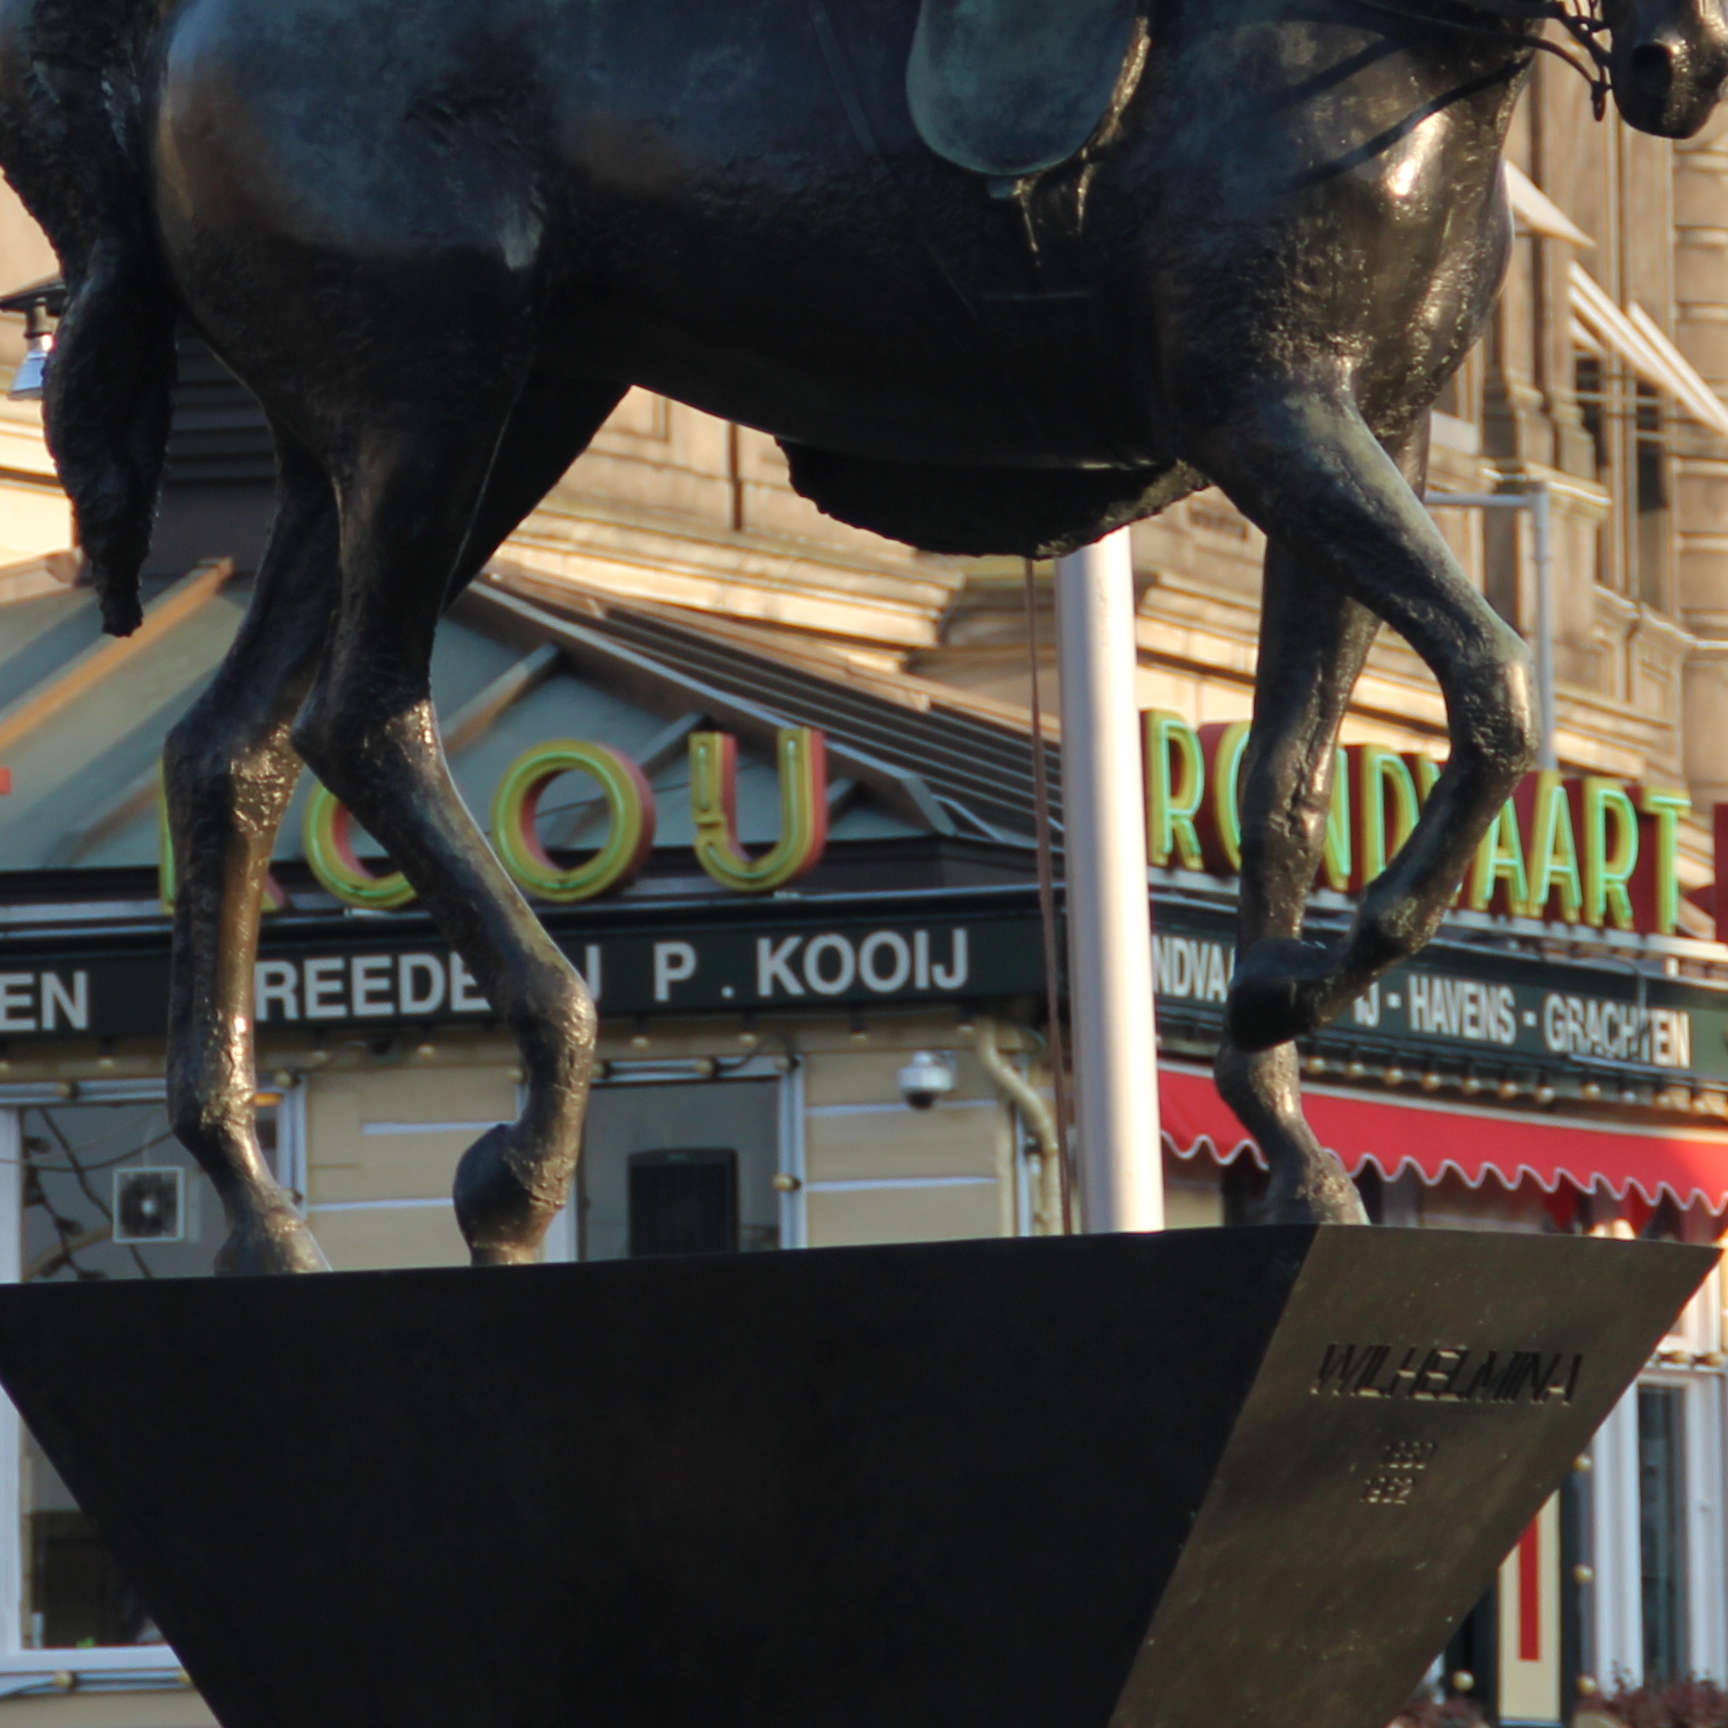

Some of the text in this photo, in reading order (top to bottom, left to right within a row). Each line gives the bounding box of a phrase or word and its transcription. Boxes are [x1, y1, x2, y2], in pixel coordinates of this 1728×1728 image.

[1139, 708, 1691, 934] RNDAART
[253, 943, 602, 1022] REEDEJ
[757, 928, 969, 998] KOOIJ
[1408, 974, 1516, 1046] HAVENS
[1544, 993, 1691, 1070] GRACHTEN
[1309, 1342, 1583, 1407] WILHELMINA
